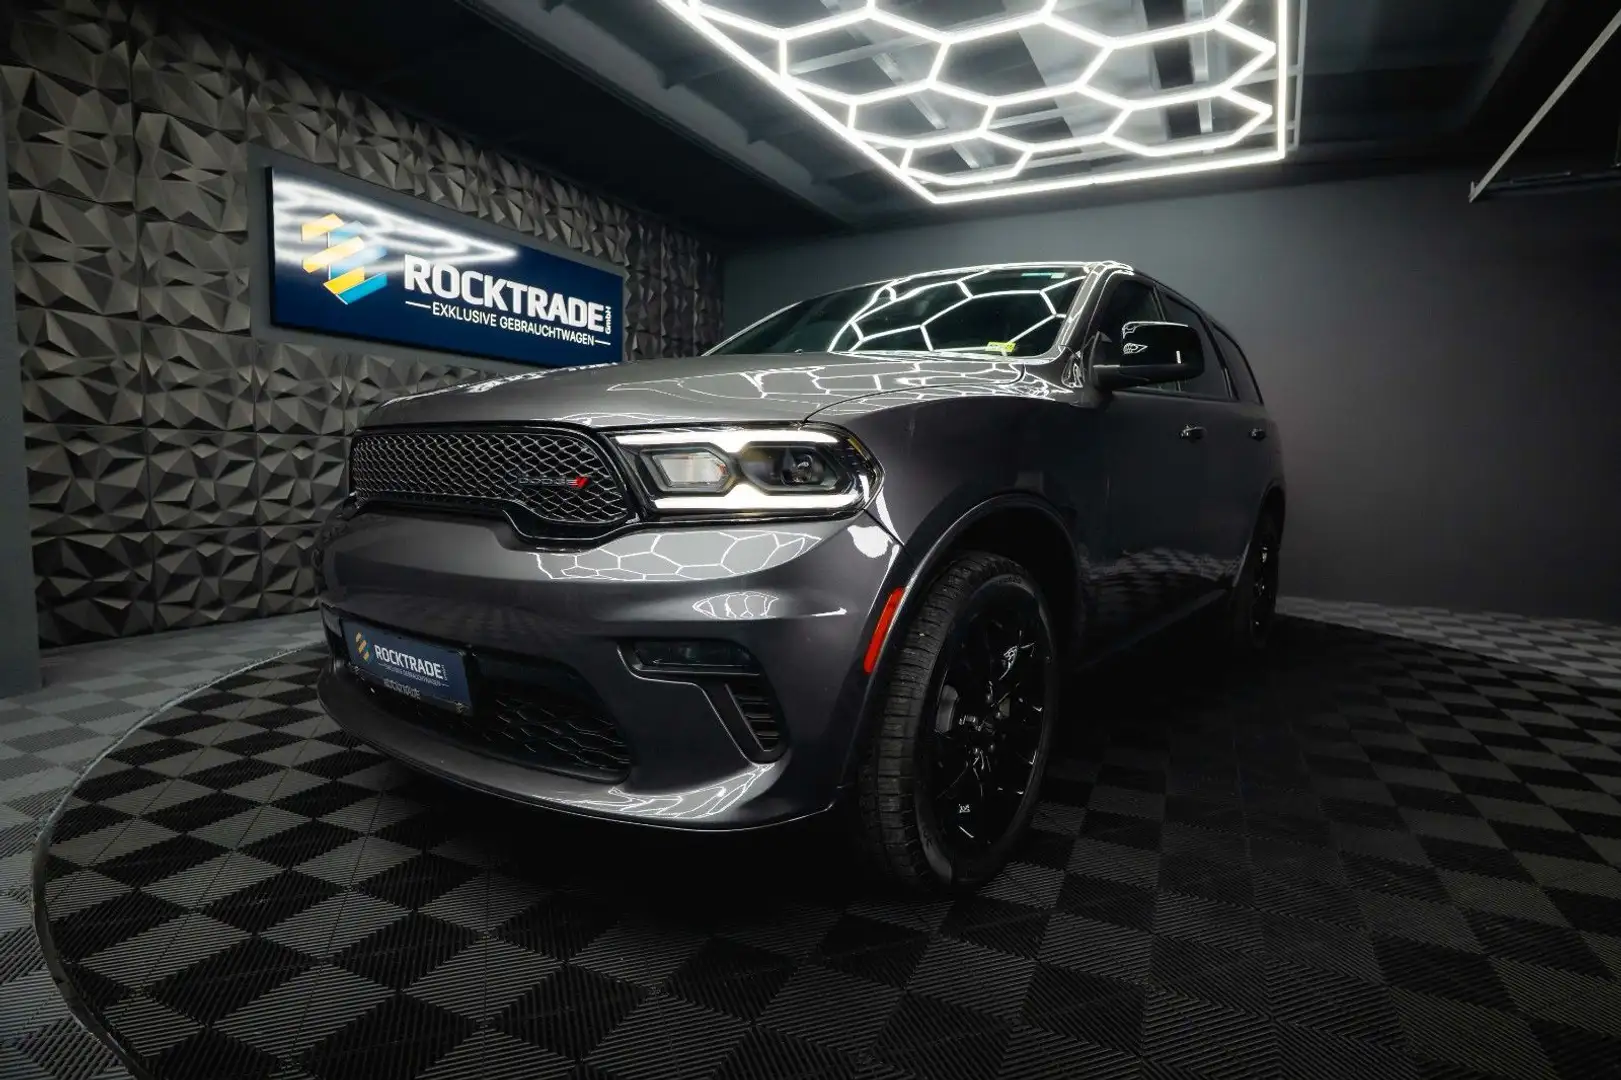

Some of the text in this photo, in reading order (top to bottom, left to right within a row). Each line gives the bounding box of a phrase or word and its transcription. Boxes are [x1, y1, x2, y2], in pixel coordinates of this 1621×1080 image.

[404, 254, 604, 332] ROCKTRADE
[432, 301, 595, 346] EXKLUSIVE GEBRAUCHTWAGEN
[604, 305, 612, 335] GmbH
[374, 644, 443, 679] ROCKTRADE
